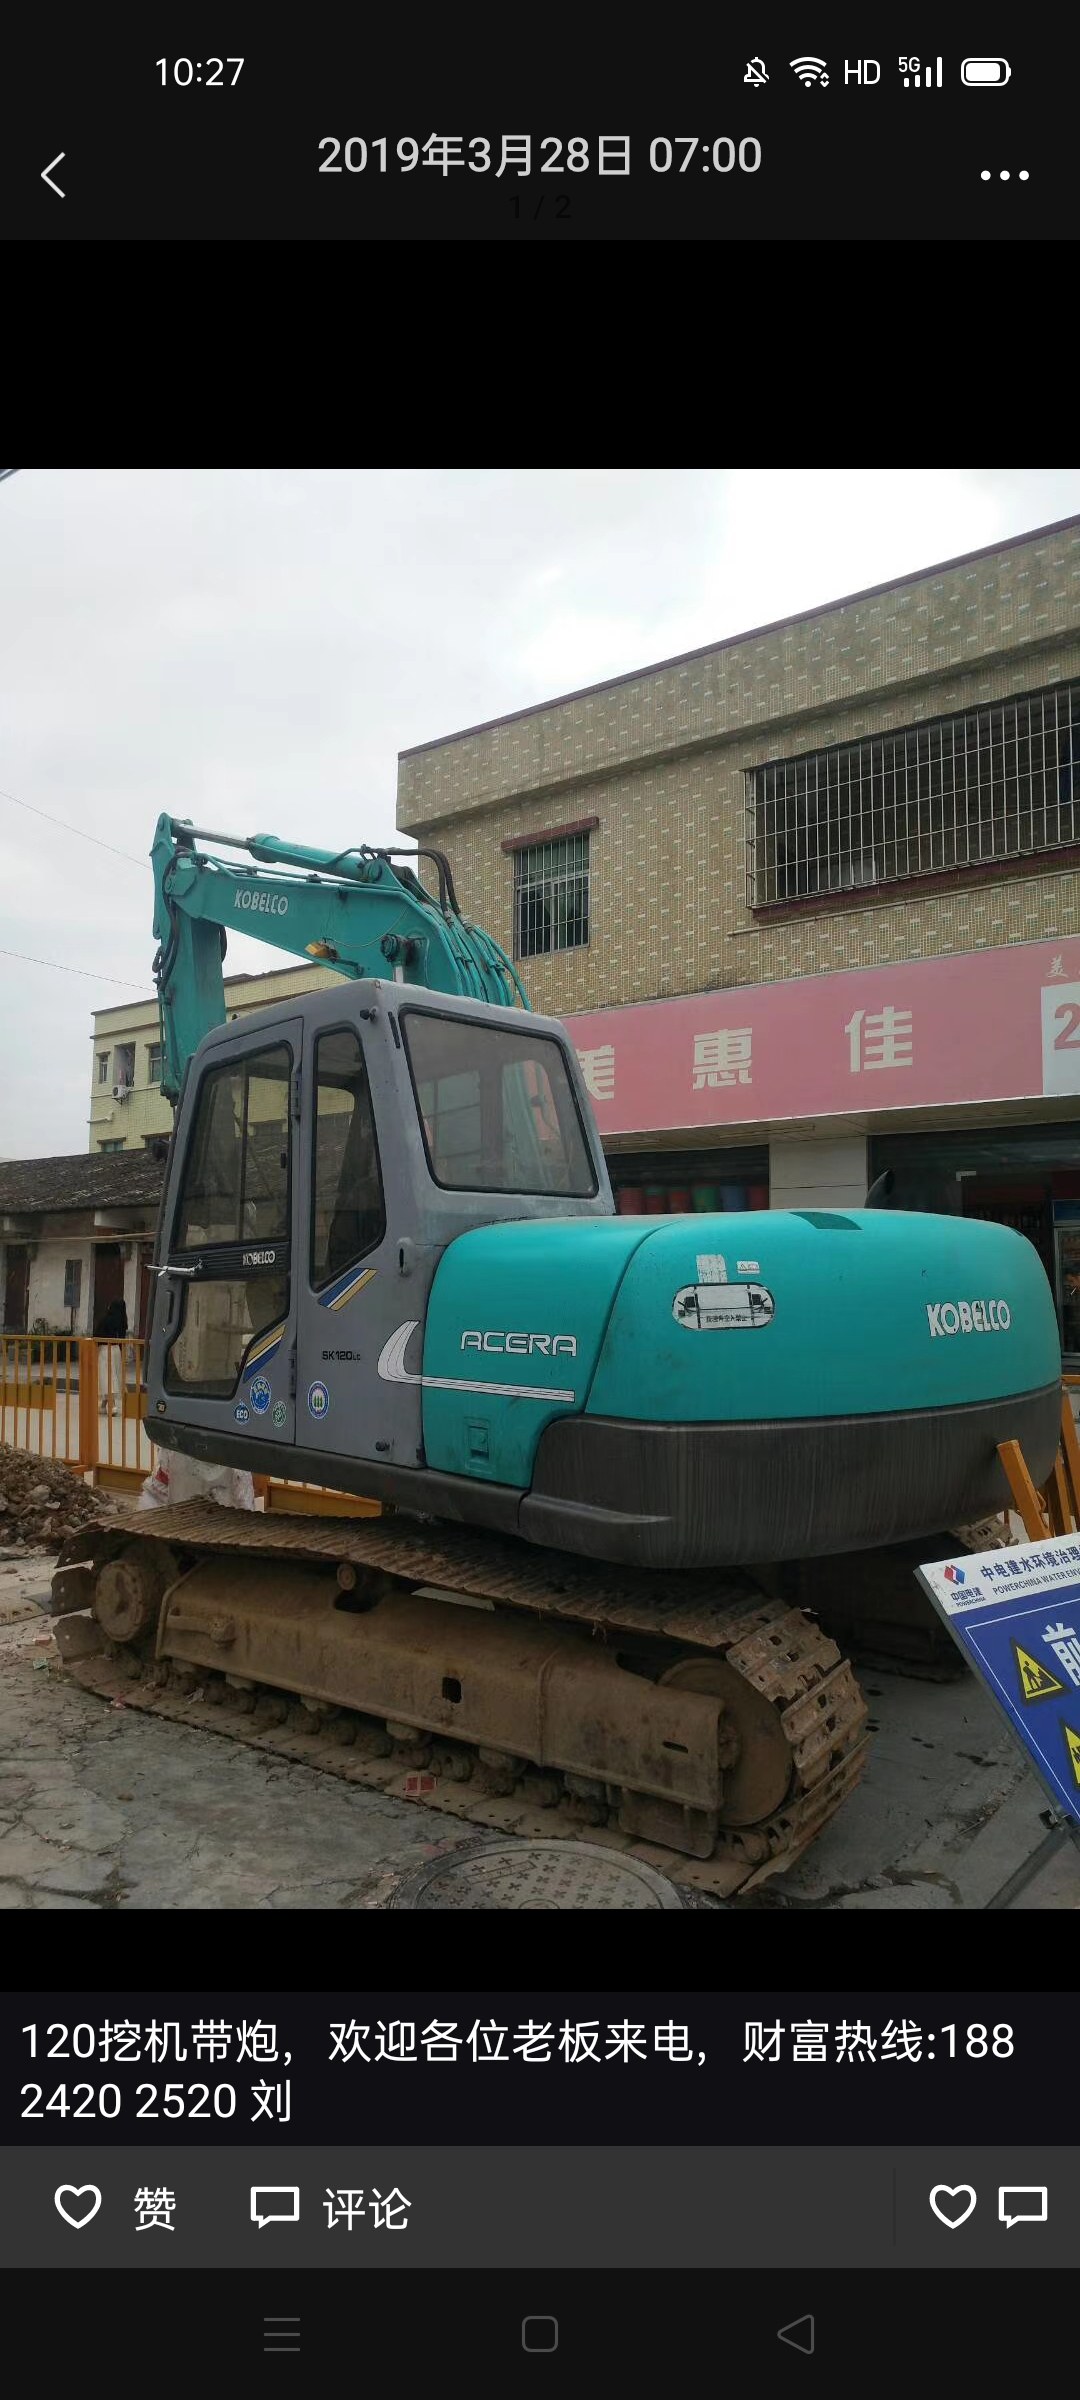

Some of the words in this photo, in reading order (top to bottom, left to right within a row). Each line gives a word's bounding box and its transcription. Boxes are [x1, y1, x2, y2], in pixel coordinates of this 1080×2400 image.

[234, 889, 289, 916] KOBELCO
[1054, 1003, 1080, 1051] 2
[242, 1250, 276, 1266] KOBELCO
[926, 1299, 1011, 1337] KOBELCO
[460, 1330, 577, 1357] ACERA
[236, 1408, 249, 1420] ECO
[980, 1545, 1080, 1582] 中电建水环境治理
[950, 1586, 984, 1602] 中国电建
[992, 1576, 1042, 1596] POWERCHINA
[1040, 1571, 1068, 1584] WATER
